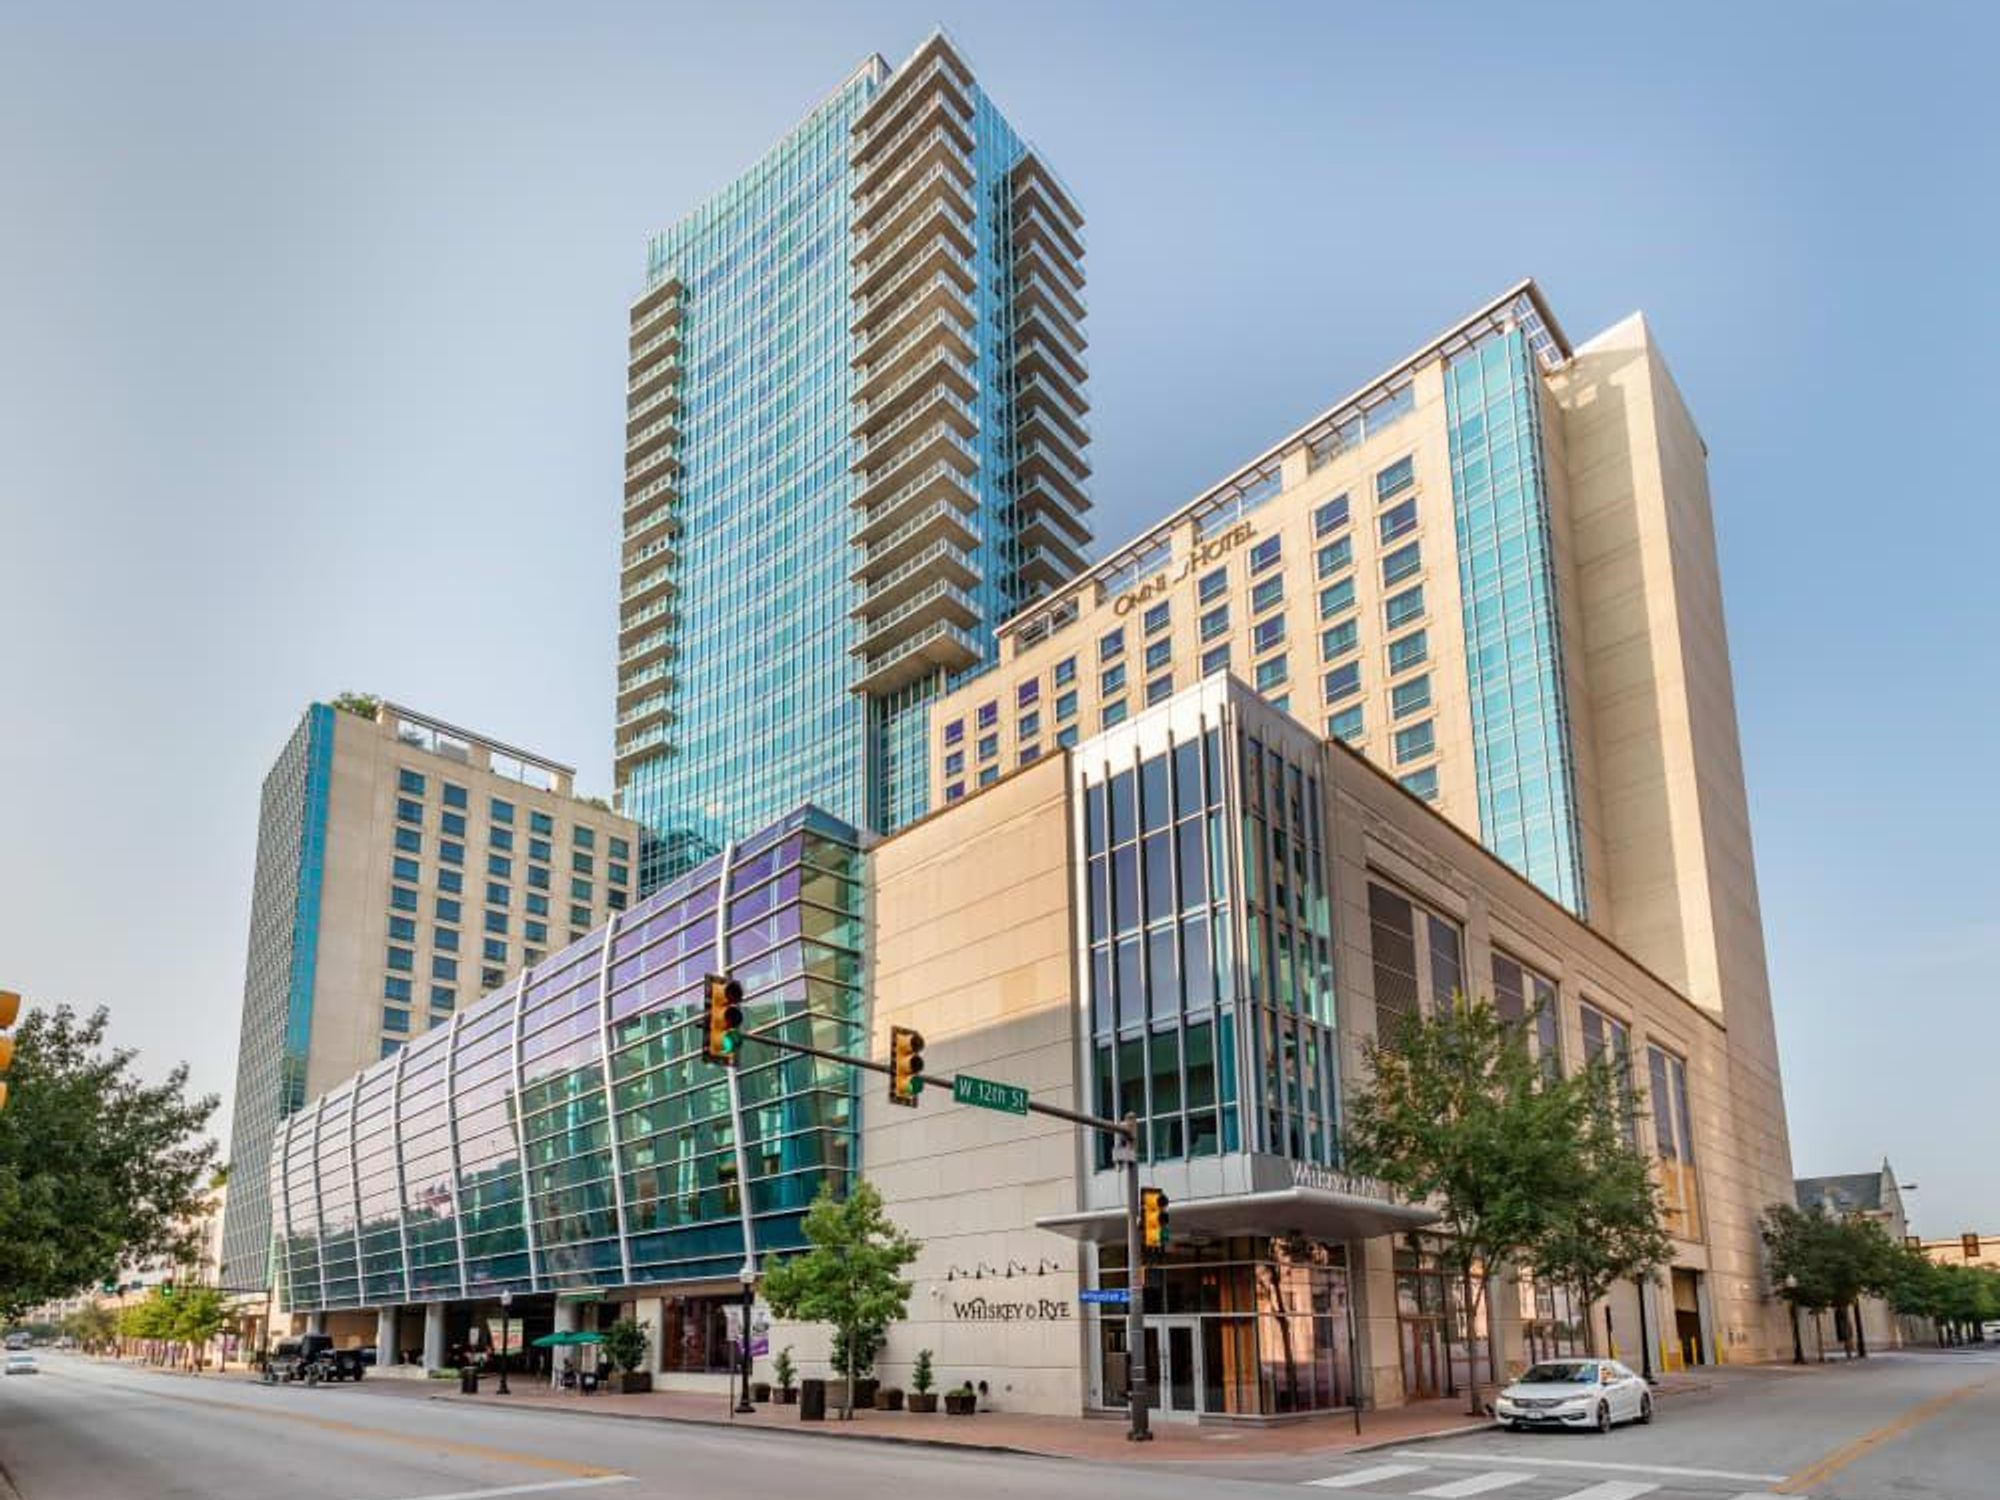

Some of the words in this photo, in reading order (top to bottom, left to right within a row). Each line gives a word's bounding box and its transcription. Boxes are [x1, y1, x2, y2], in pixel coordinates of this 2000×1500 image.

[1114, 574, 1167, 616] OMNI
[1175, 521, 1257, 582] HOTEL
[959, 1078, 972, 1097] W
[979, 1082, 1006, 1105] 12th
[1012, 1090, 1024, 1108] St
[953, 1297, 1023, 1322] WHISKEY
[1038, 1298, 1071, 1320] RYE
